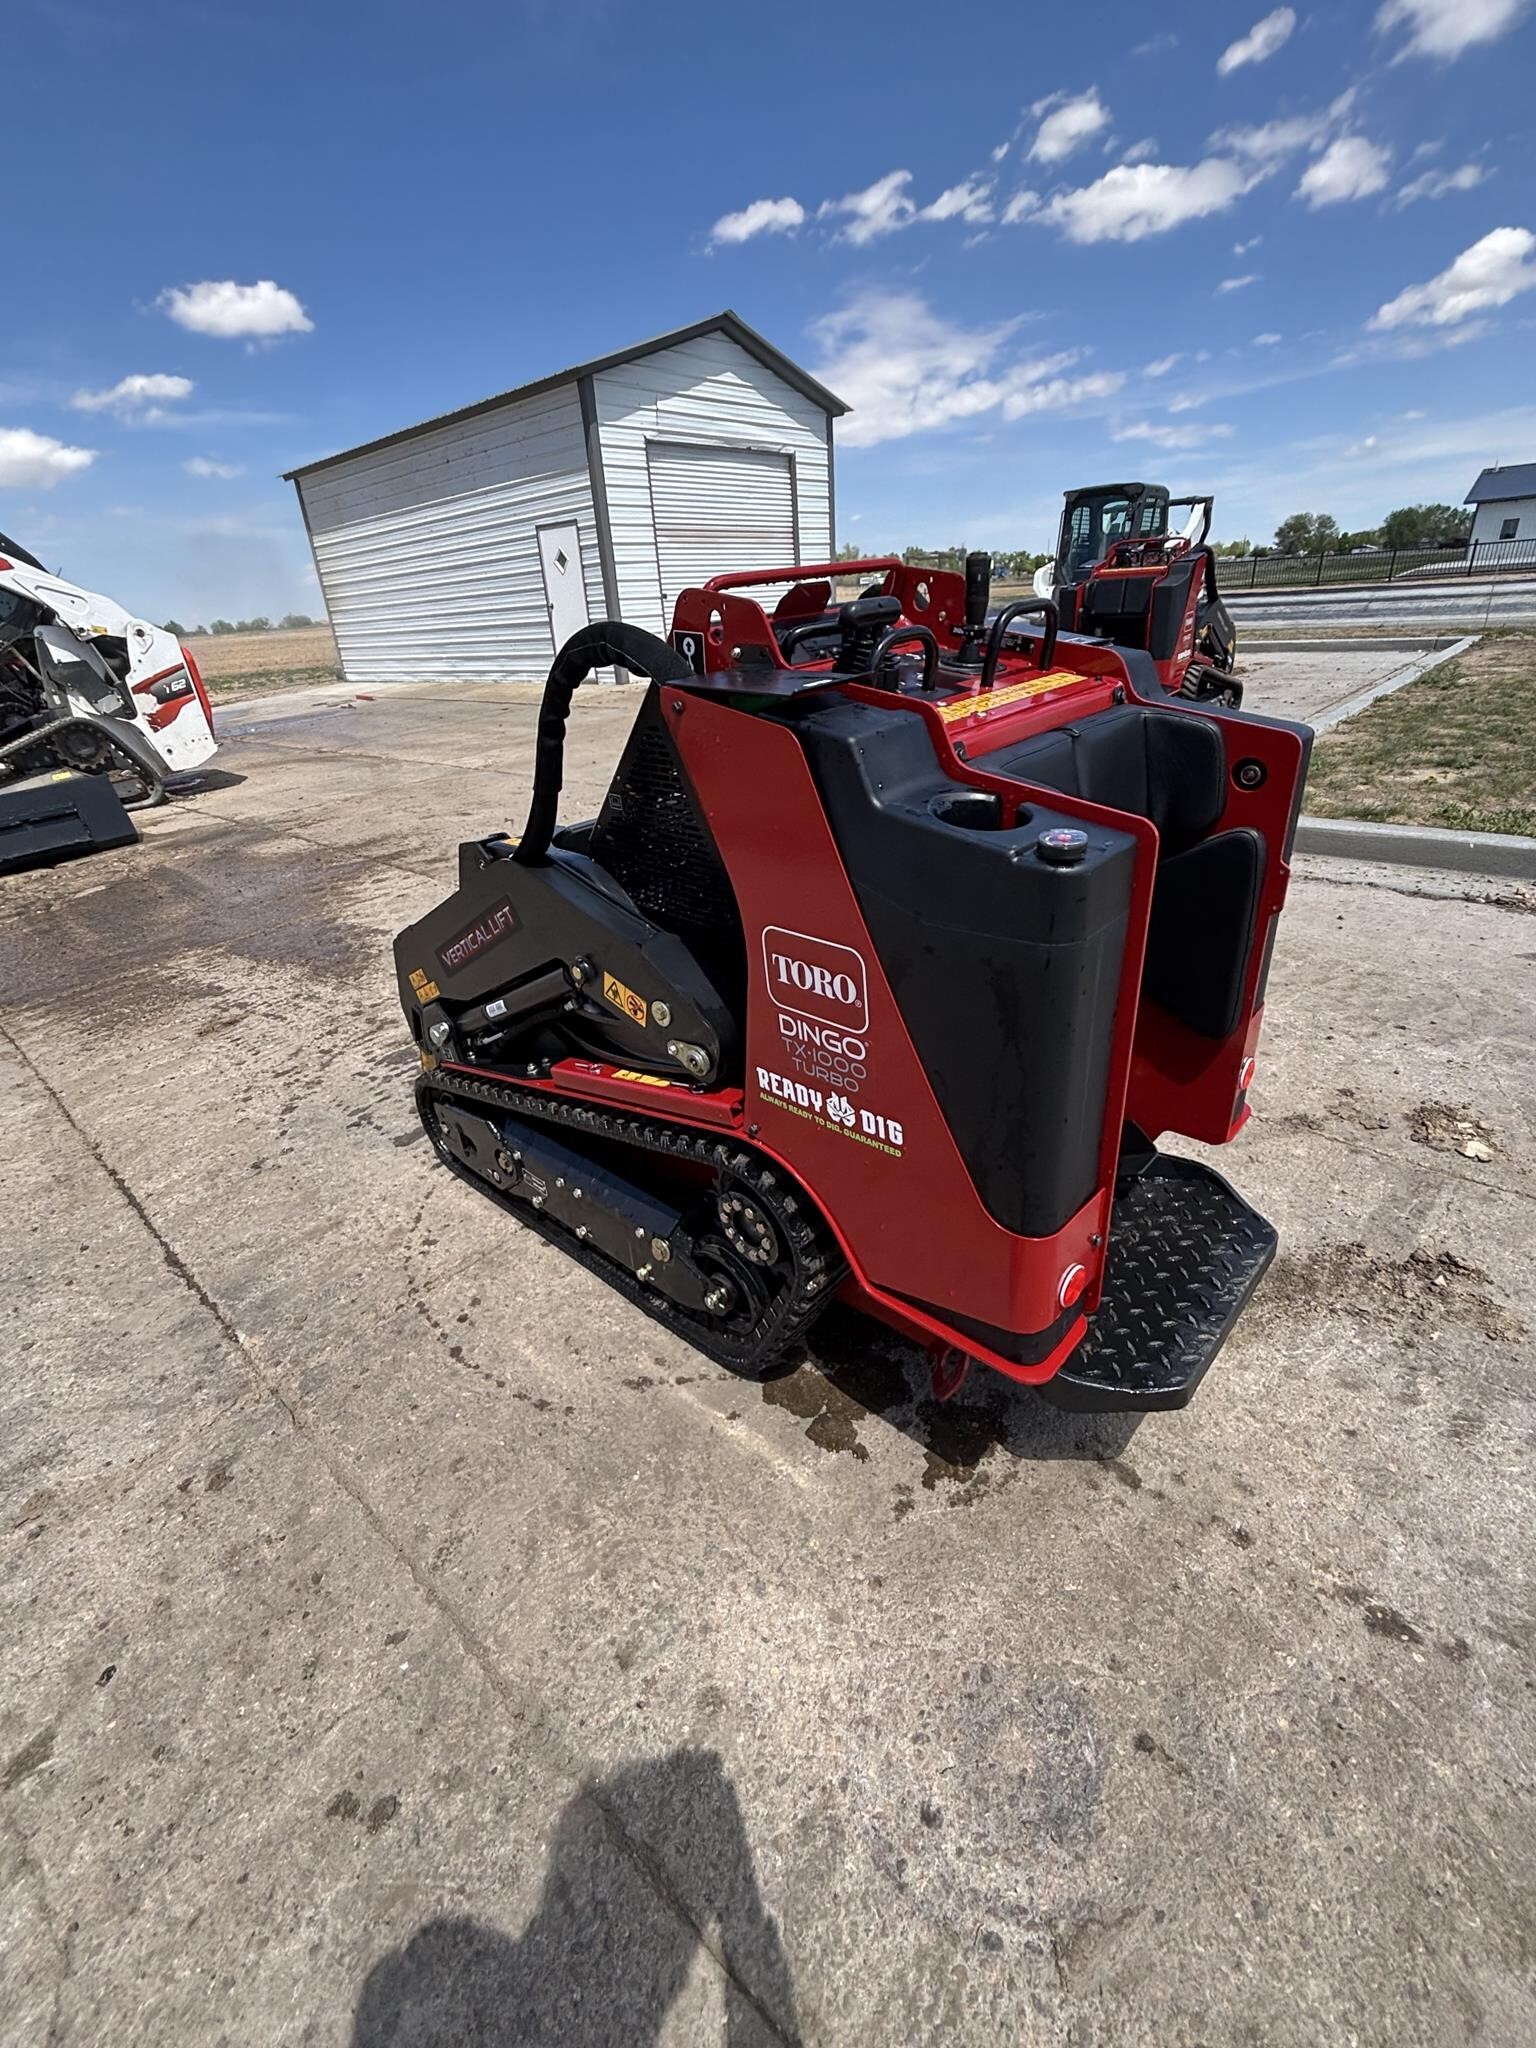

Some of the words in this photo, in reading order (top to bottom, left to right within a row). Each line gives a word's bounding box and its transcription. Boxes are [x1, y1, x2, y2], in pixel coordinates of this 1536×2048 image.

[441, 926, 492, 967] VERTICAL
[488, 906, 513, 934] LIFT
[772, 953, 857, 1004] TORO
[778, 1013, 866, 1060] DINGO
[791, 1056, 859, 1093] TURBO
[756, 1066, 823, 1113] READY
[859, 1108, 903, 1146] DIG
[760, 1092, 788, 1110] ALWAYS
[788, 1104, 813, 1120] READY
[813, 1115, 826, 1126] TO
[843, 1128, 902, 1158] GUARANTEED
